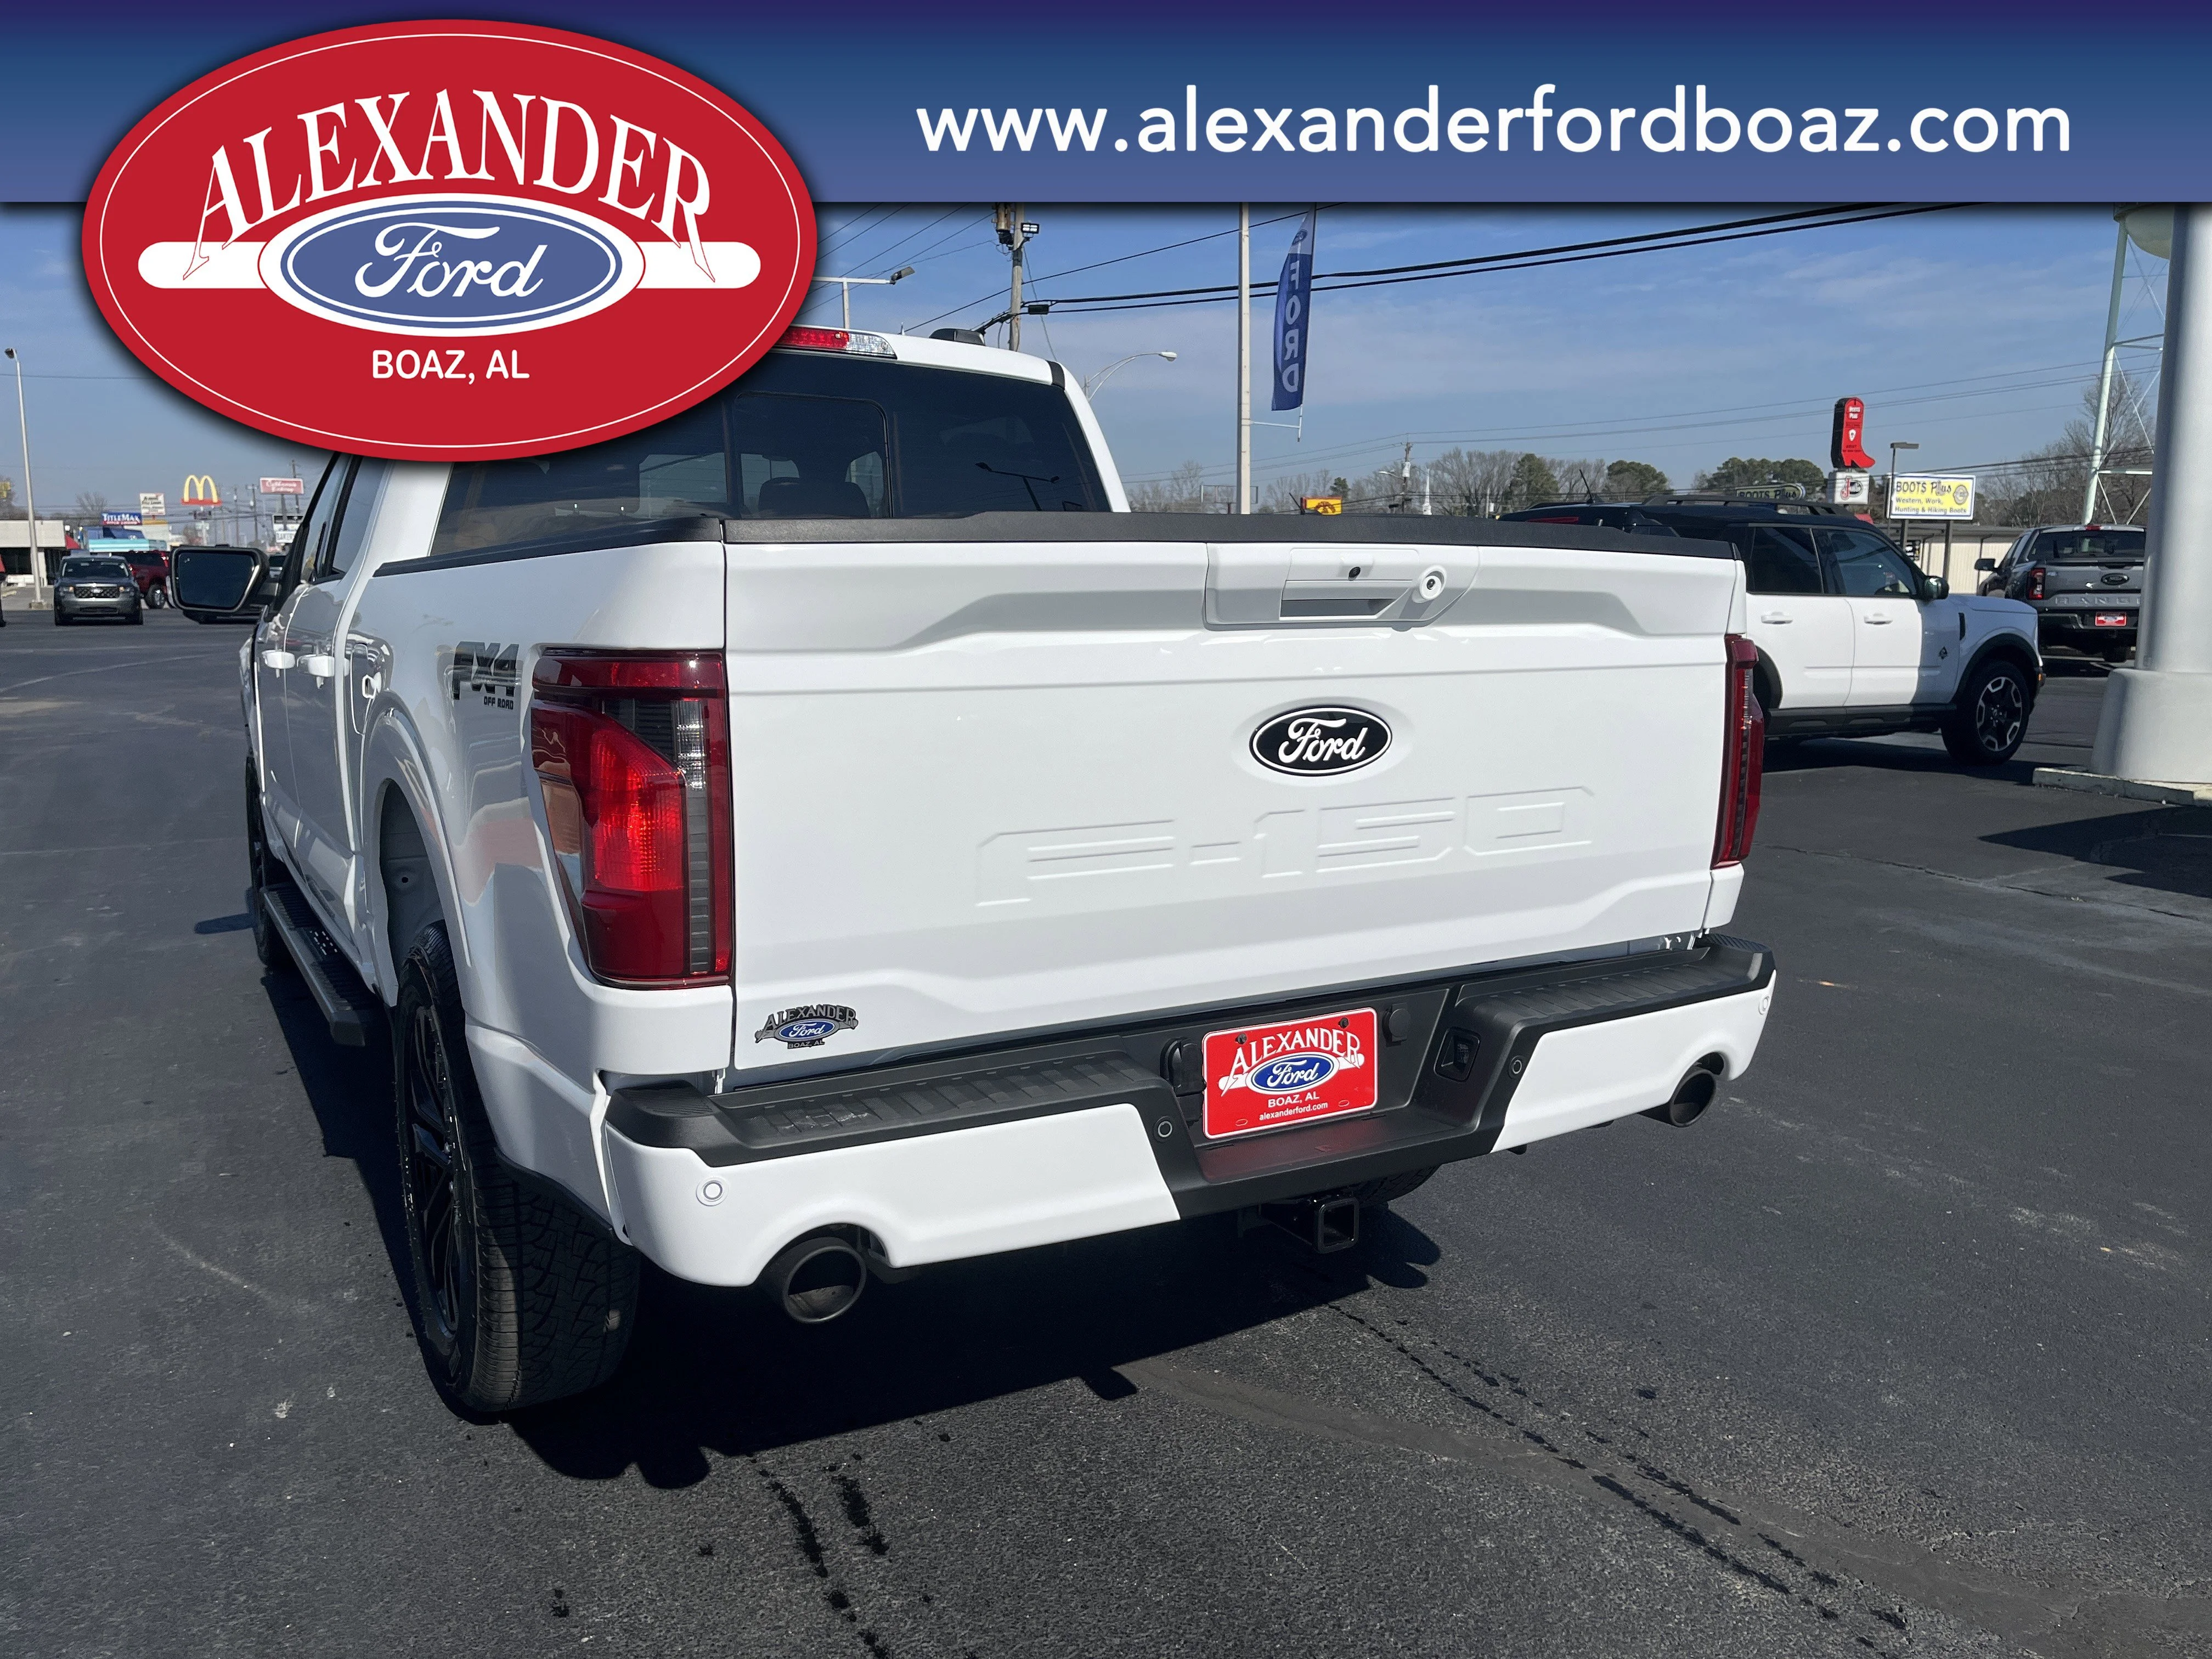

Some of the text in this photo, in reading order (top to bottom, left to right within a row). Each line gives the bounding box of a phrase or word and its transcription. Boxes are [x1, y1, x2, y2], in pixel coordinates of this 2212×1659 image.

[1896, 481, 1927, 493] BOOTS
[1895, 506, 1920, 515] Hunting
[1928, 507, 1948, 515] Hiking
[452, 641, 520, 701] FX4
[483, 696, 514, 710] OFF ROAD
[1278, 717, 1369, 764] Ford
[975, 785, 1595, 907] F-150
[755, 1004, 858, 1043] ALEXANDER
[788, 1022, 825, 1038] Ford
[1221, 1027, 1361, 1097] ALEXANDER
[1266, 1059, 1319, 1088] Ford
[1259, 1102, 1328, 1121] alexanderford.com
[1268, 1091, 1320, 1108] BOAZ, AL
